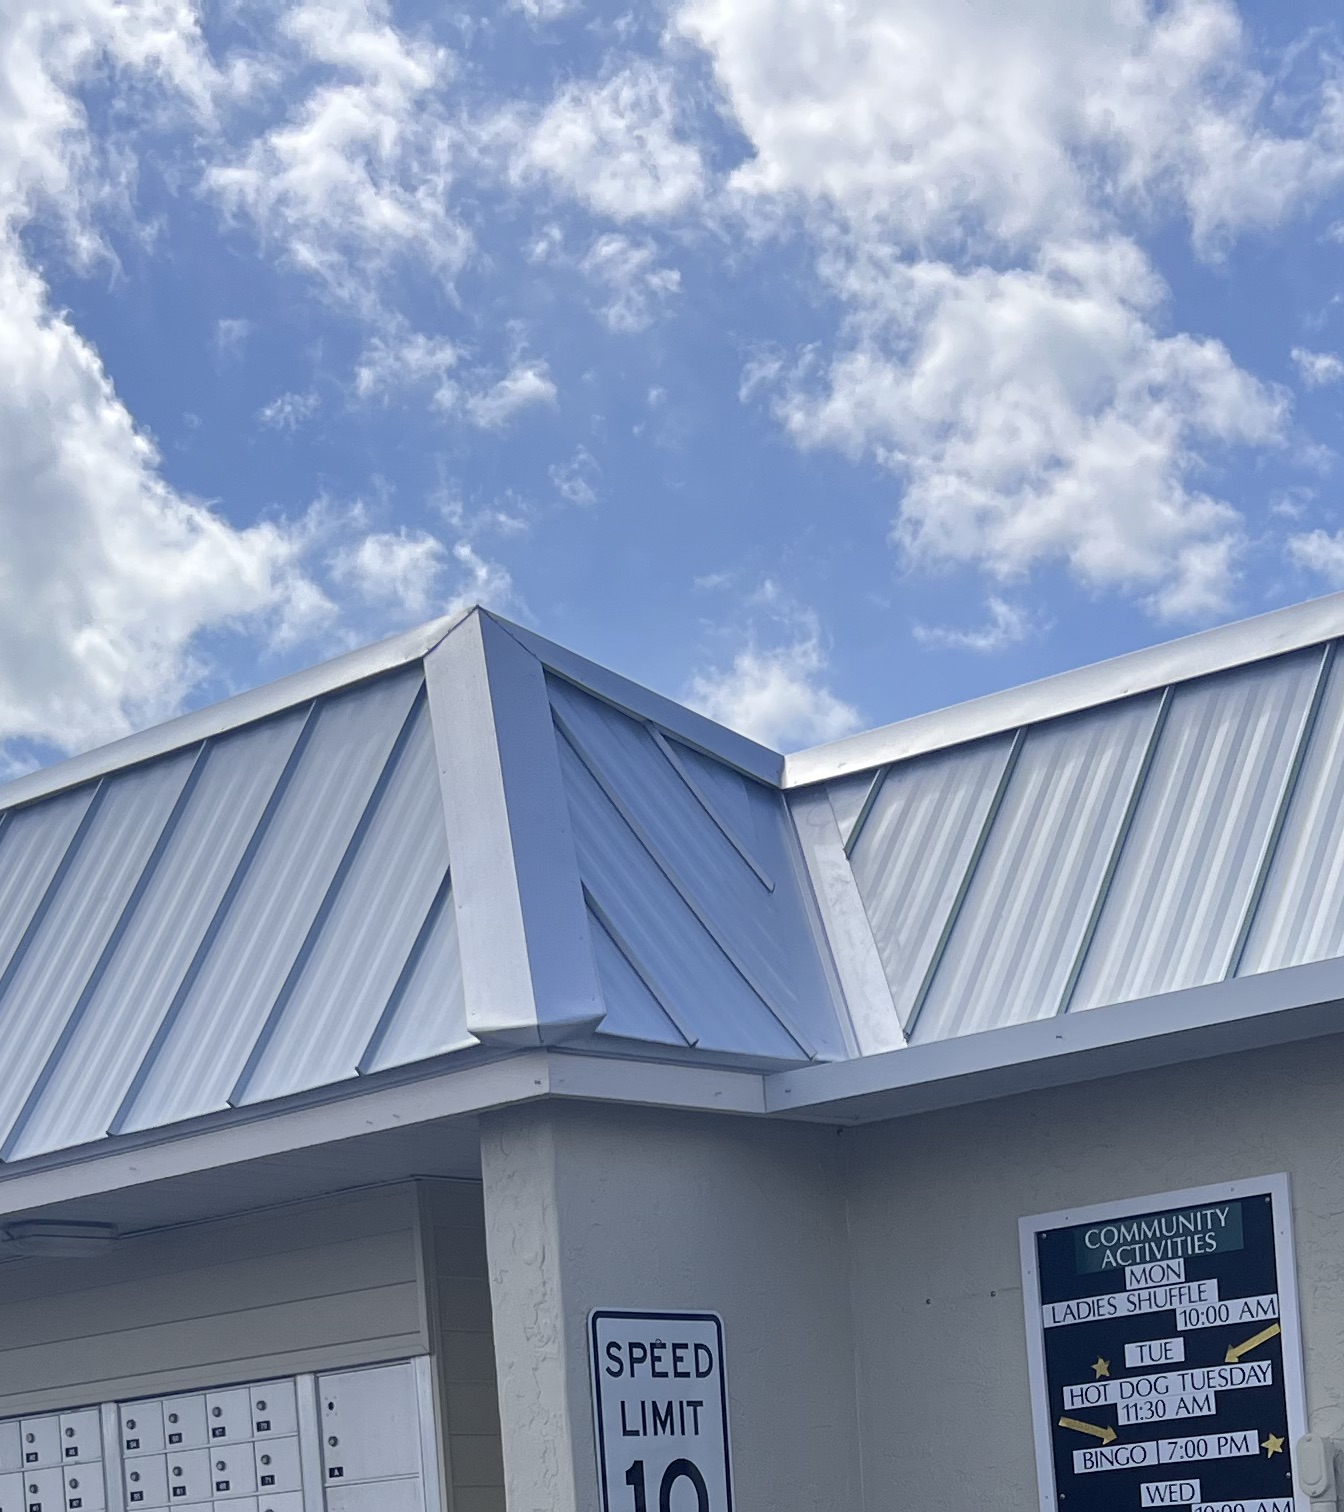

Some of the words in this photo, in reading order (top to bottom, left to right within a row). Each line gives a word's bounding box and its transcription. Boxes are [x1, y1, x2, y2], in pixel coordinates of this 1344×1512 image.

[1085, 1207, 1230, 1249] COMMUNITY
[1101, 1233, 1217, 1269] ACTIVITIES
[1129, 1261, 1182, 1287] MON
[1052, 1296, 1117, 1323] LADIES
[1127, 1283, 1207, 1312] SHUFFLE
[1179, 1308, 1229, 1328] 10:00
[1239, 1298, 1276, 1320] AM
[605, 1341, 713, 1378] SPEED
[1136, 1342, 1174, 1363] TUE
[1069, 1384, 1110, 1406] HOT
[1119, 1376, 1169, 1398] DOG
[1177, 1364, 1272, 1391] TUESDAY
[620, 1400, 703, 1437] LIMIT
[1122, 1400, 1166, 1421] 11:30
[1176, 1395, 1211, 1415] AM
[1083, 1445, 1147, 1470] BINGO
[1168, 1440, 1207, 1460] 7:00
[1218, 1436, 1250, 1455] PM
[1146, 1484, 1195, 1503] WED
